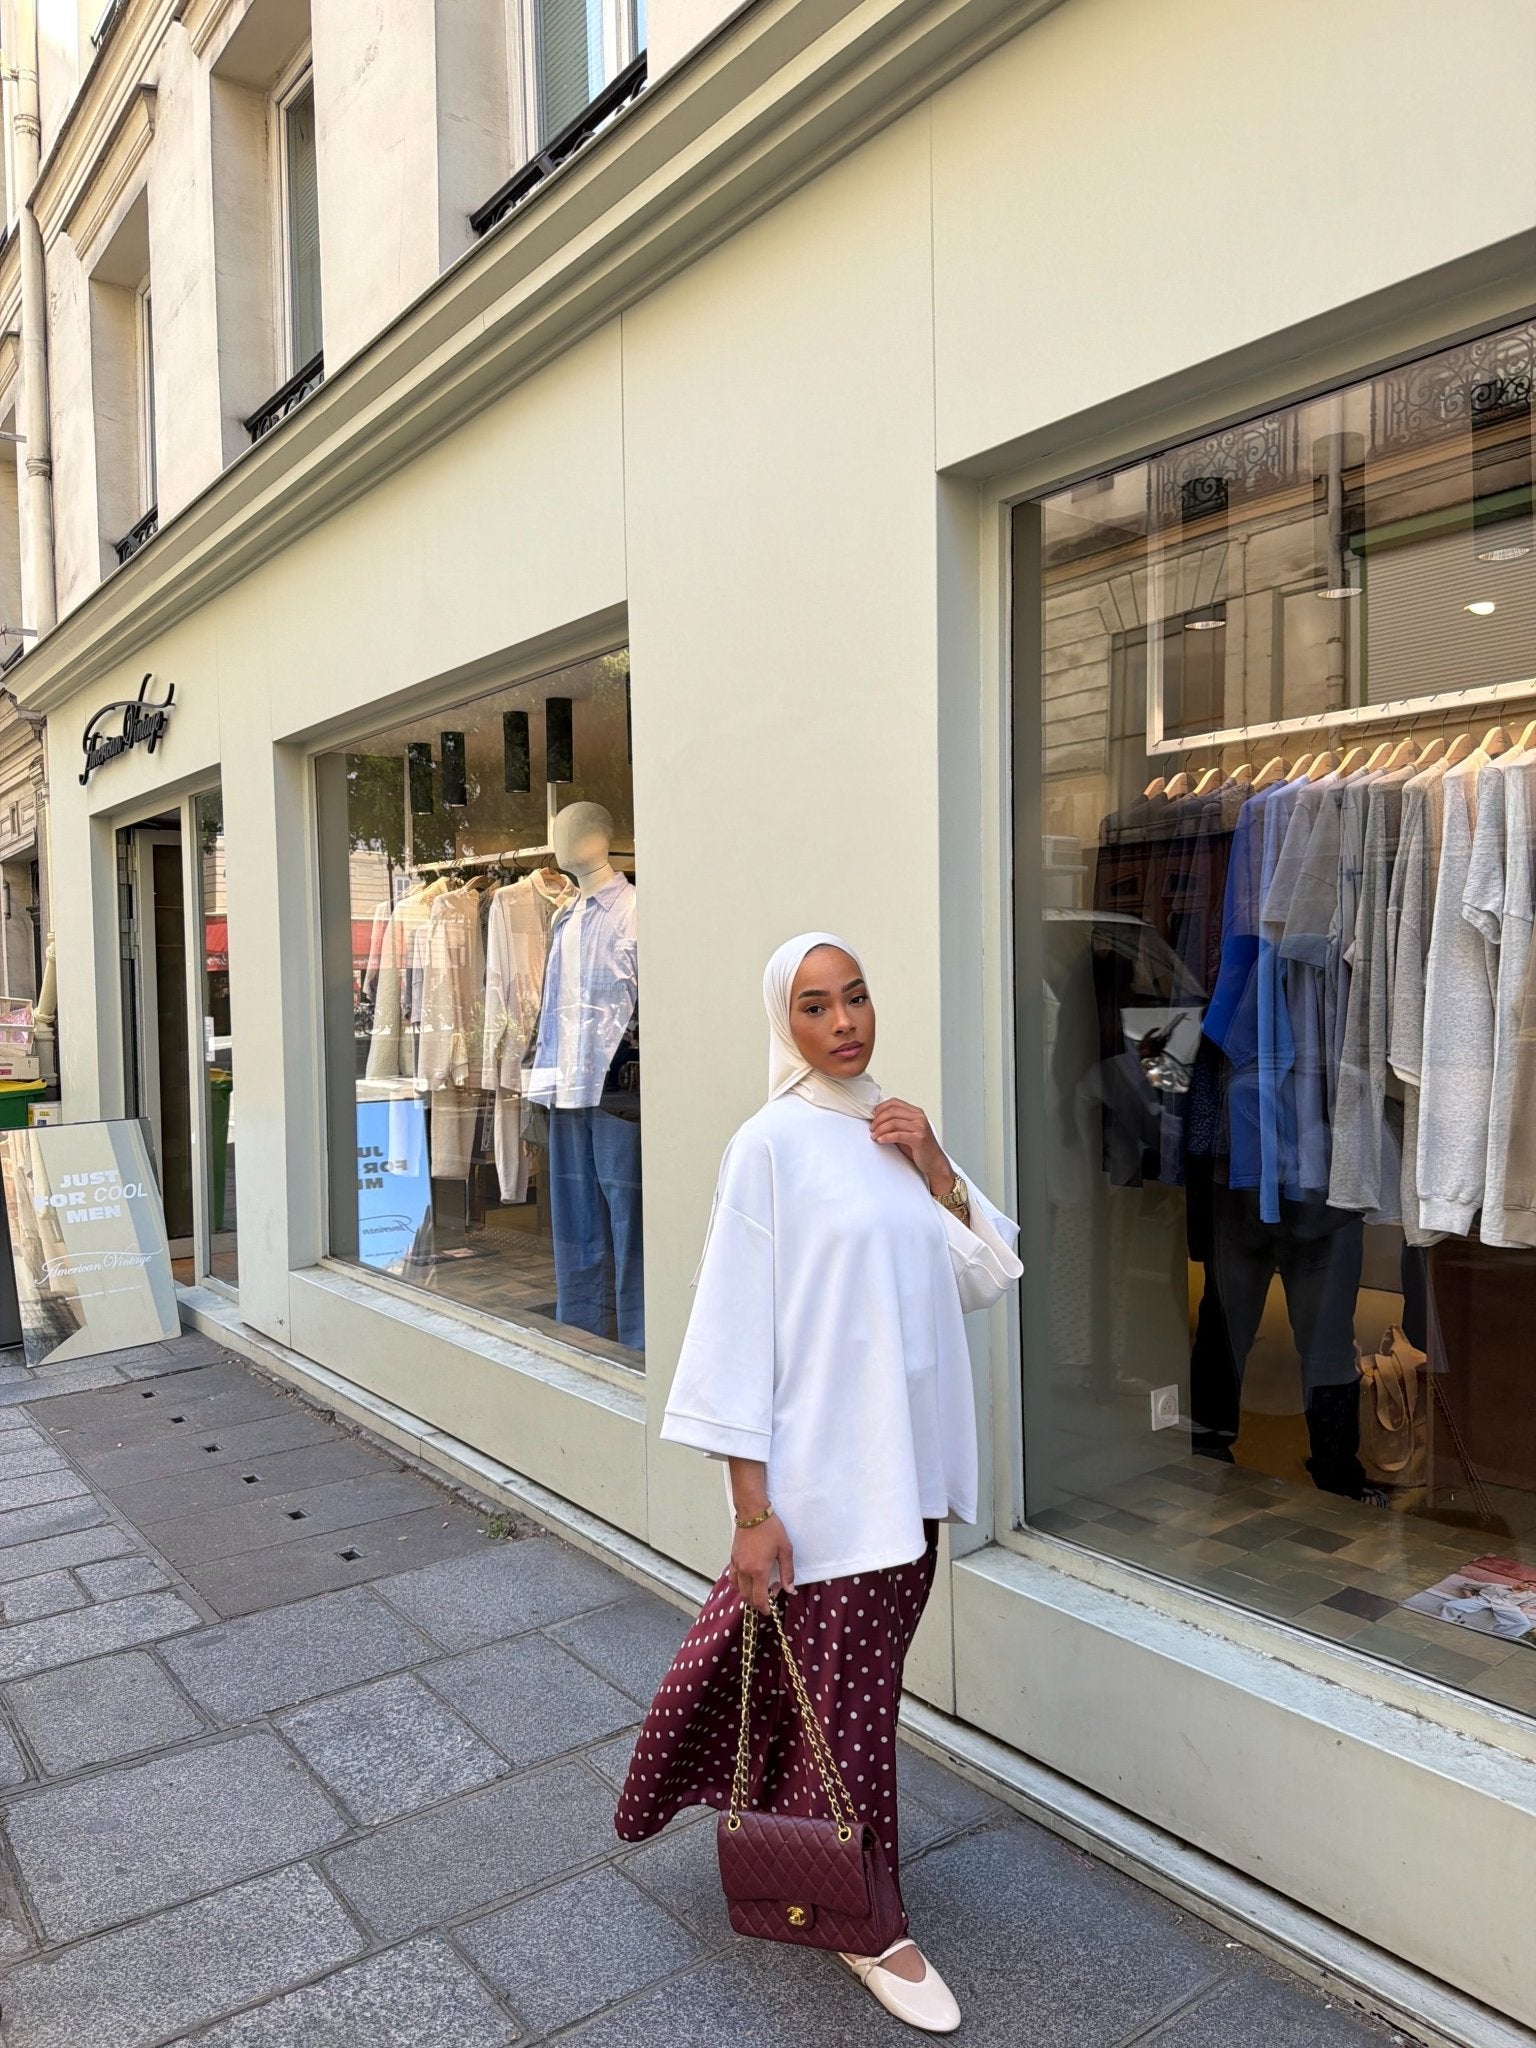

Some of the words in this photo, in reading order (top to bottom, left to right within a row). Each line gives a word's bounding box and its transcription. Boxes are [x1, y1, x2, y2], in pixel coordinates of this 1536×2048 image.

[60, 1169, 118, 1189] JUST
[33, 1191, 87, 1210] FOR
[94, 1182, 148, 1203] COOL
[66, 1205, 121, 1224] MEN
[102, 1243, 153, 1269] Vintage
